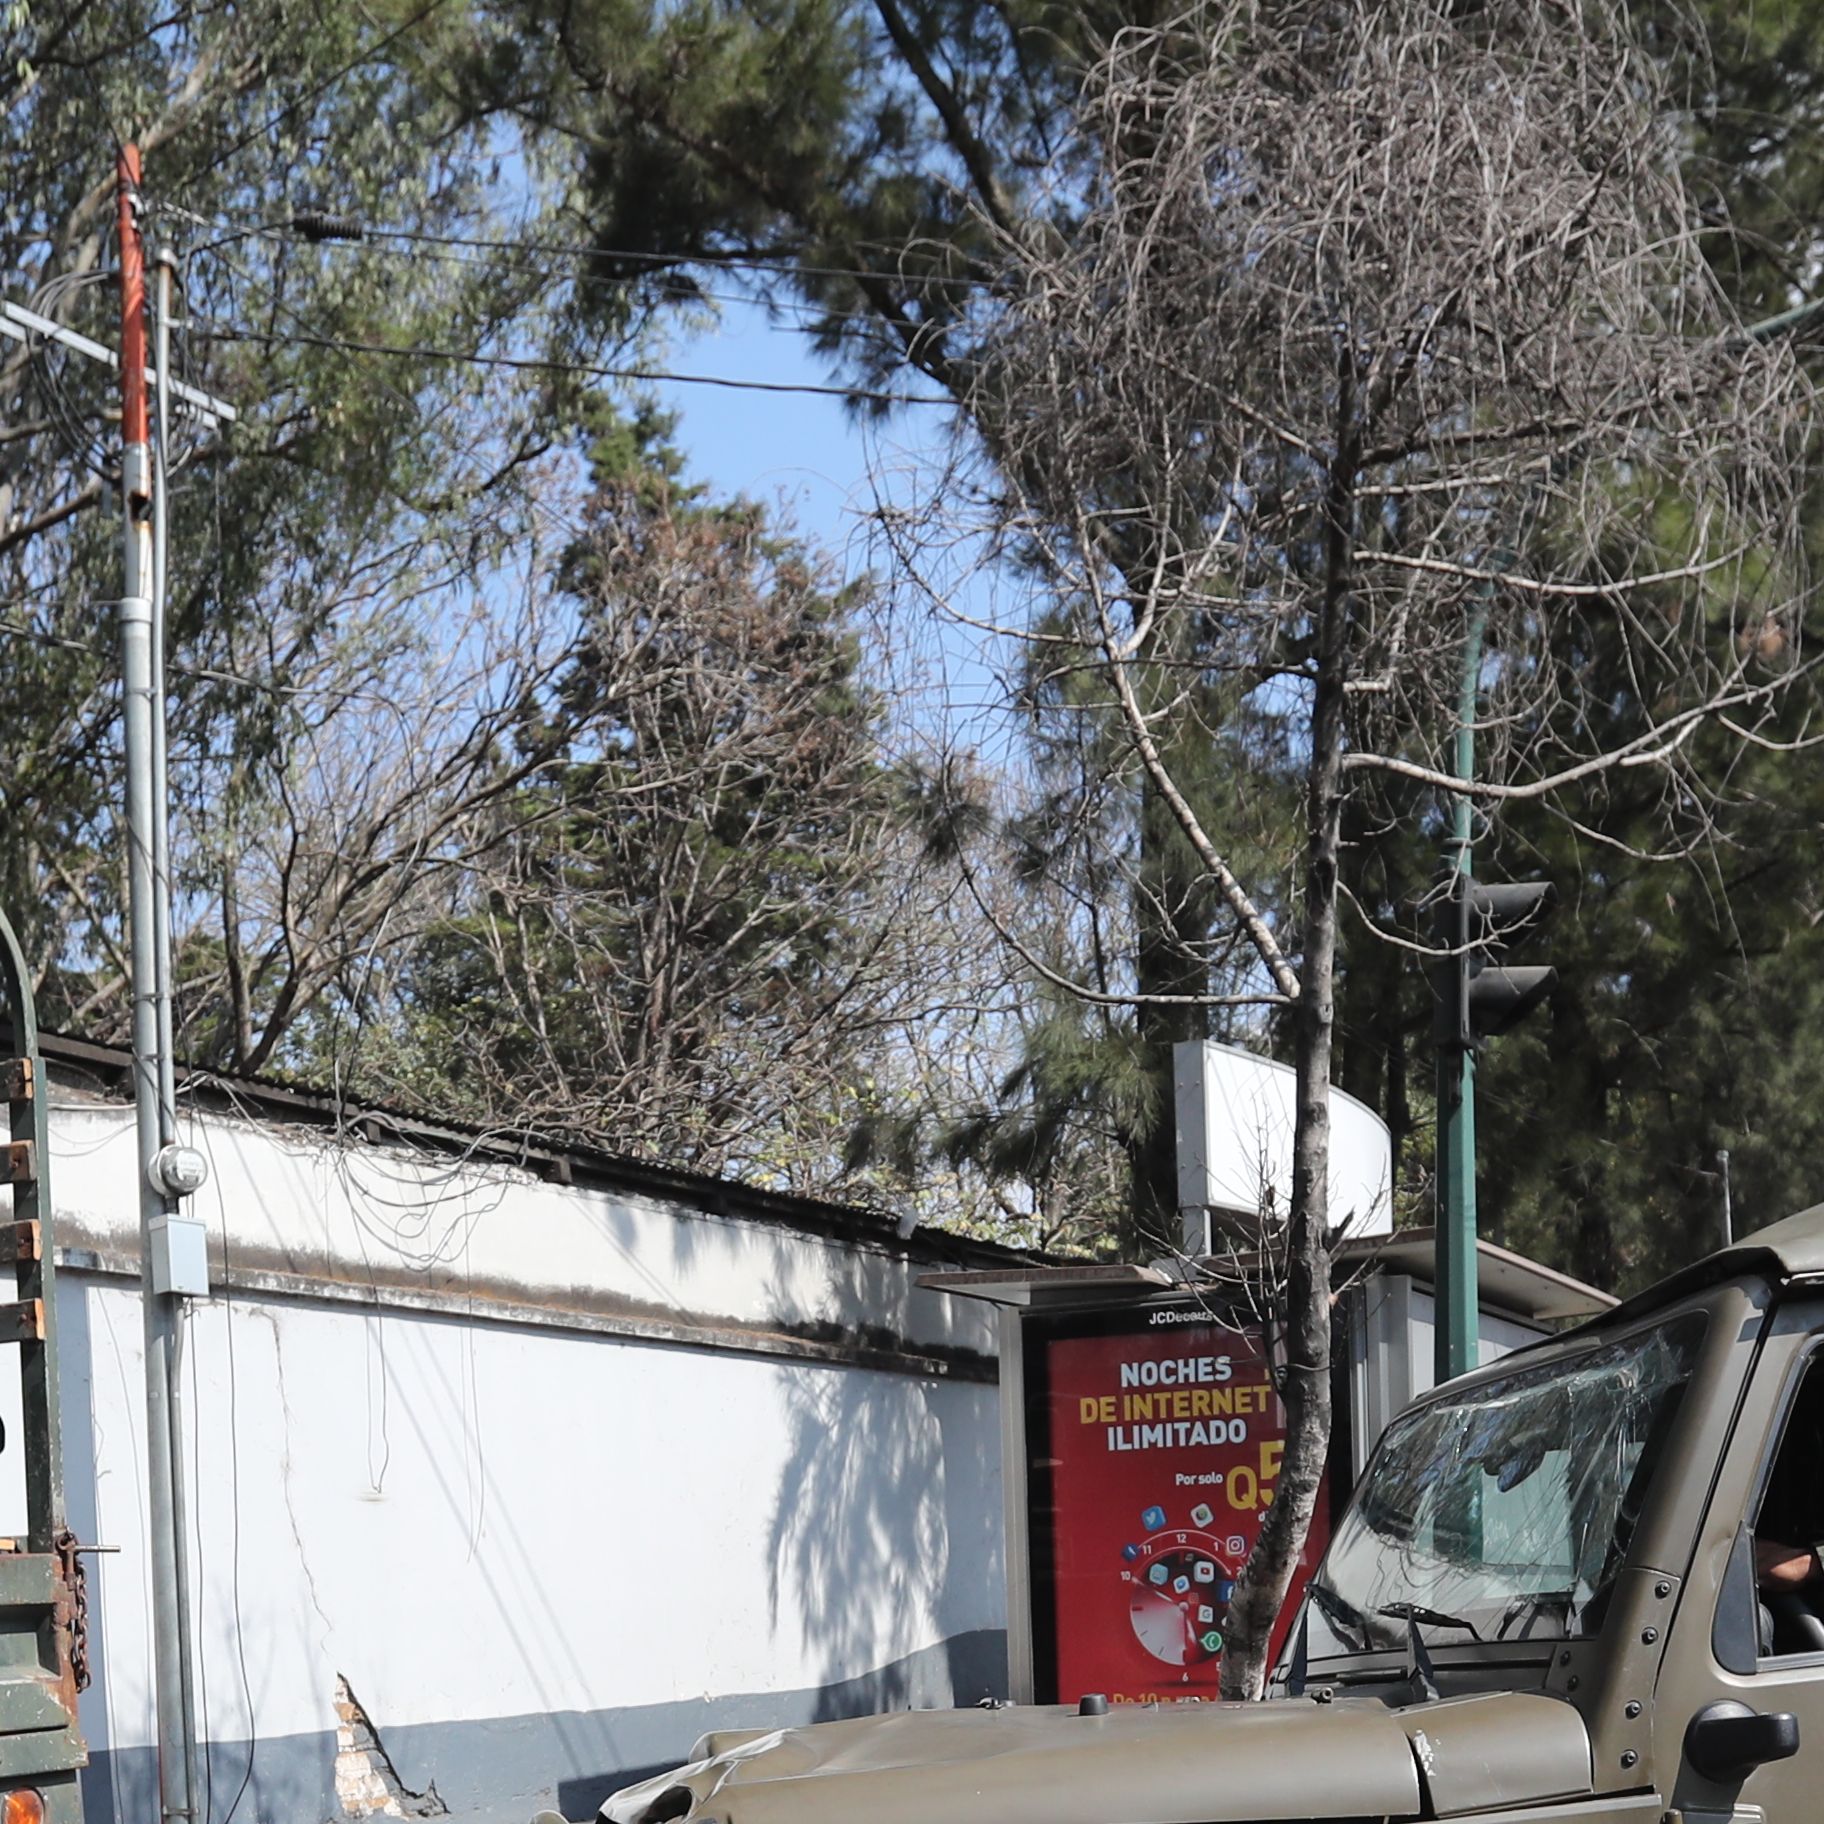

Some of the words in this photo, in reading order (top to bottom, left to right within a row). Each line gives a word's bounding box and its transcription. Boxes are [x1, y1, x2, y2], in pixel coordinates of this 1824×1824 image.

[1120, 1356, 1232, 1388] NOCHES
[1080, 1396, 1117, 1424] DE
[1124, 1385, 1272, 1422] INTERNET
[1107, 1418, 1247, 1451] ILIMITADO
[1175, 1473, 1197, 1486] Por
[1198, 1471, 1224, 1485] solo
[1176, 1533, 1187, 1544] 12
[1142, 1545, 1152, 1555] 11
[1120, 1570, 1131, 1581] 10
[1182, 1672, 1189, 1682] 6
